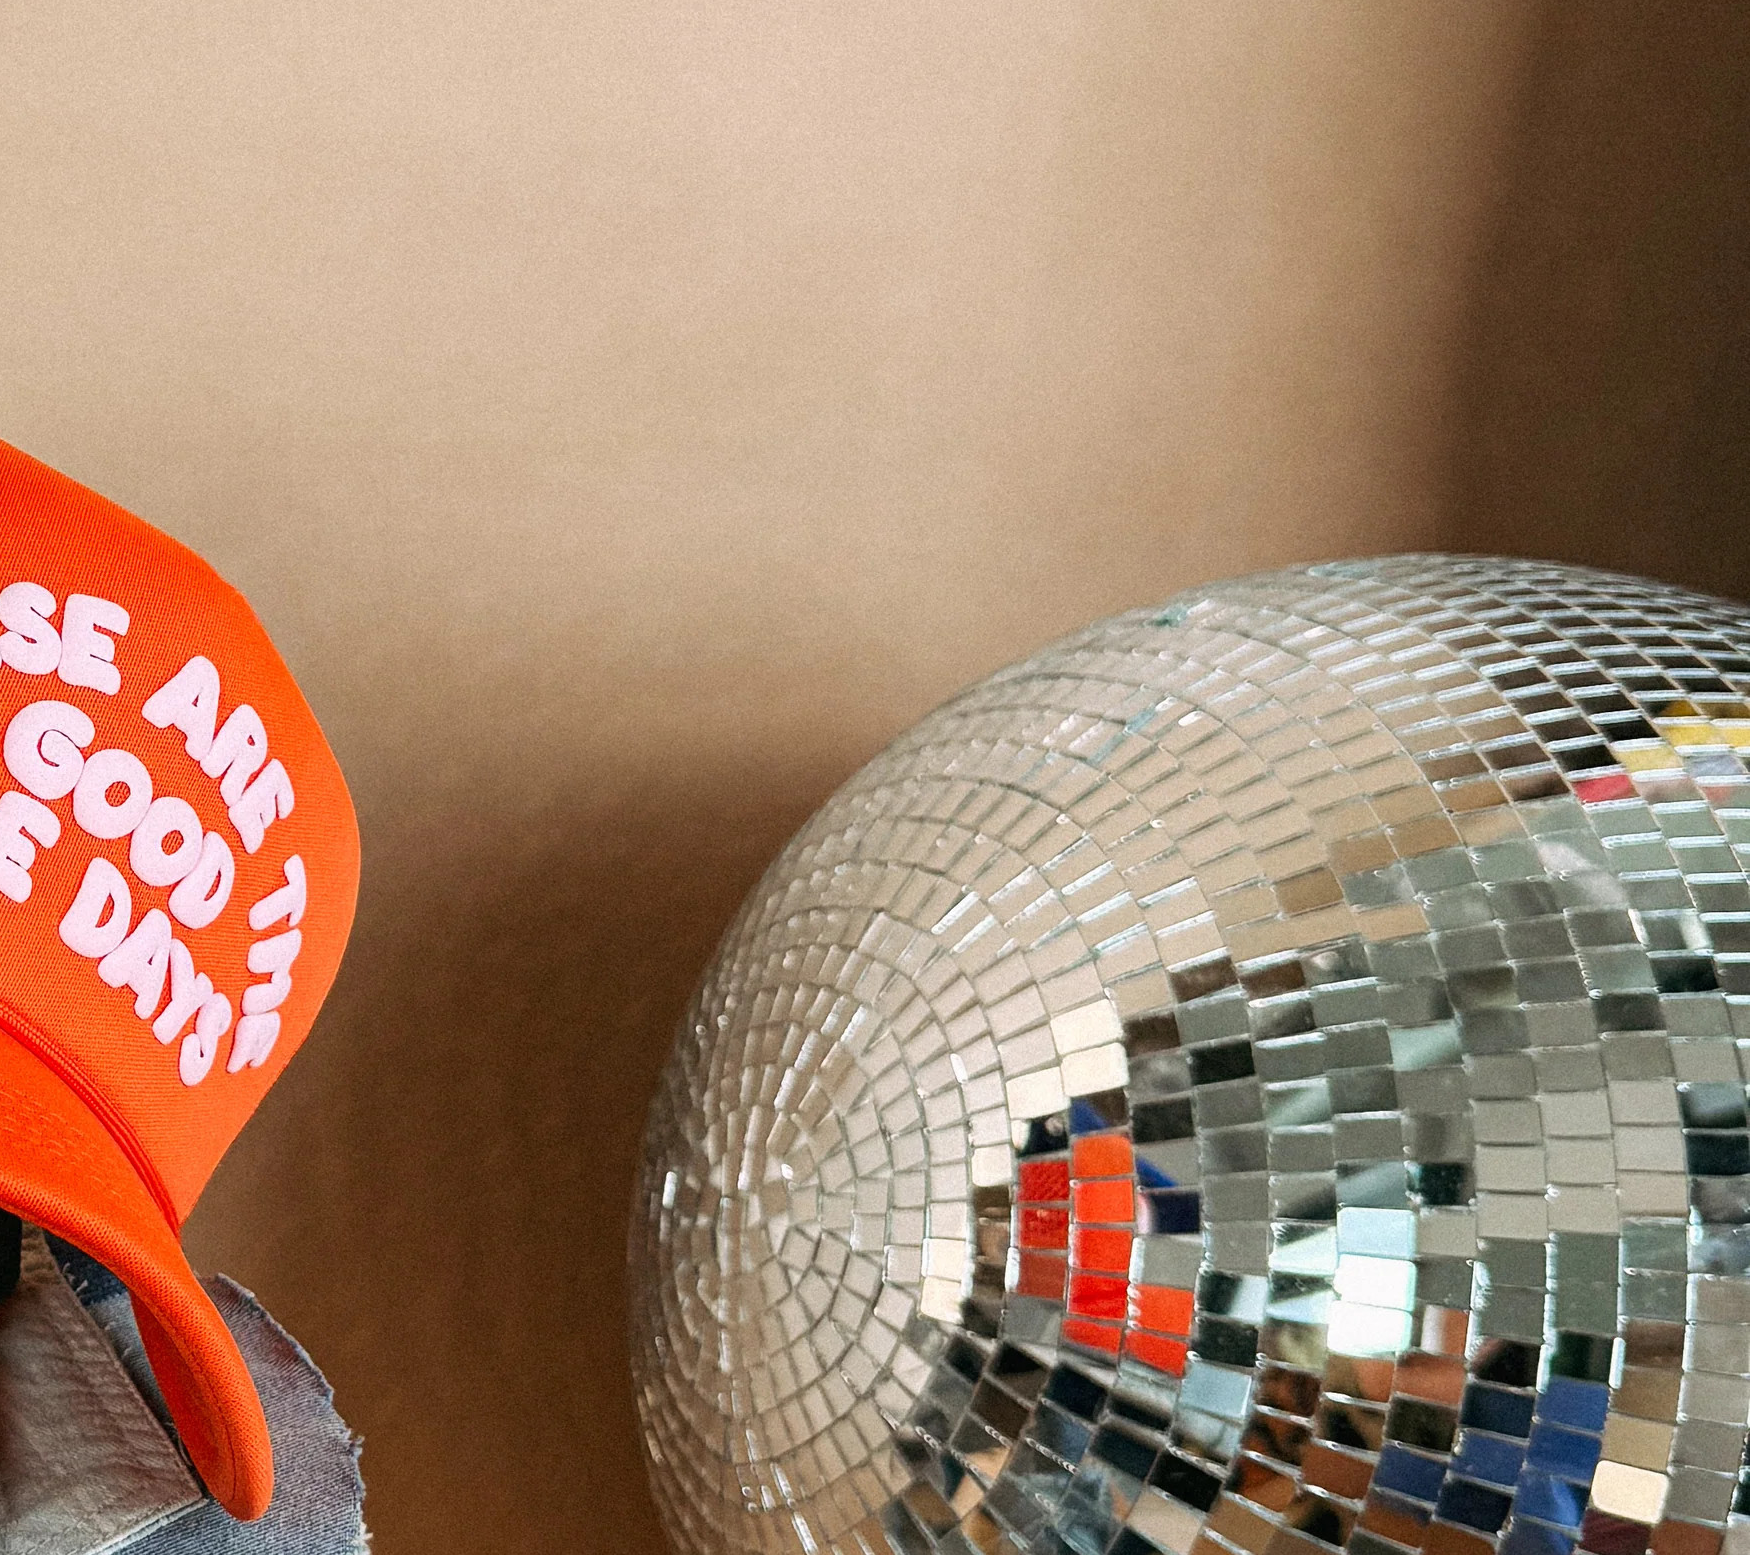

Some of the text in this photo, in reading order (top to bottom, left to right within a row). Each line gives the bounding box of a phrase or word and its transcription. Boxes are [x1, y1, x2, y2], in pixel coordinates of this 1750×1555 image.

[3, 699, 235, 930] GOOD
[141, 655, 295, 854] ARE
[226, 854, 307, 1074] THE
[58, 856, 233, 1087] DAYS
